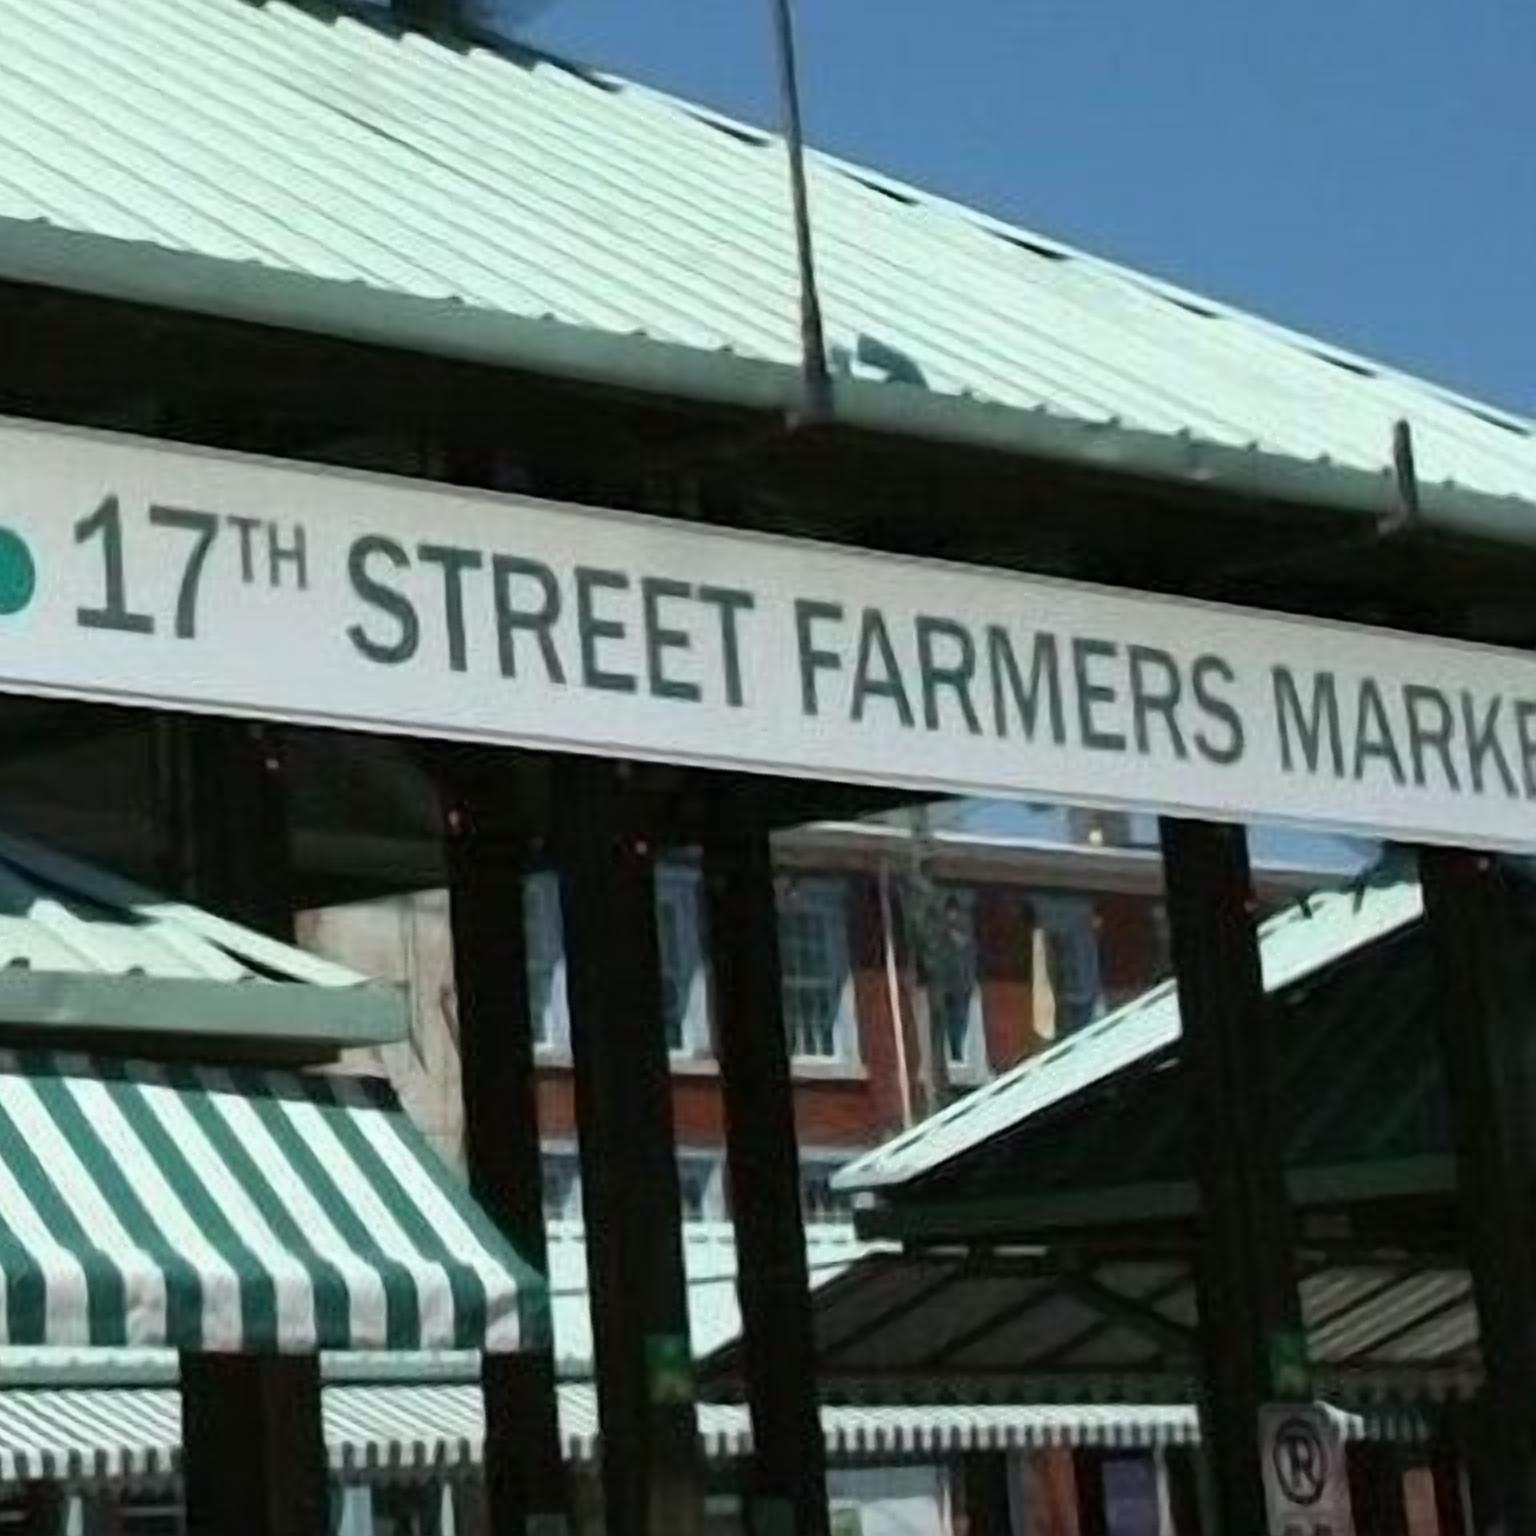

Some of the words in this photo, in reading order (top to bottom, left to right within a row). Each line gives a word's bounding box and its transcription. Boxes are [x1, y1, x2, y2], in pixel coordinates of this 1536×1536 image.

[74, 495, 308, 639] 17TH
[347, 534, 756, 708] STREET
[793, 597, 1246, 766] FARMERS
